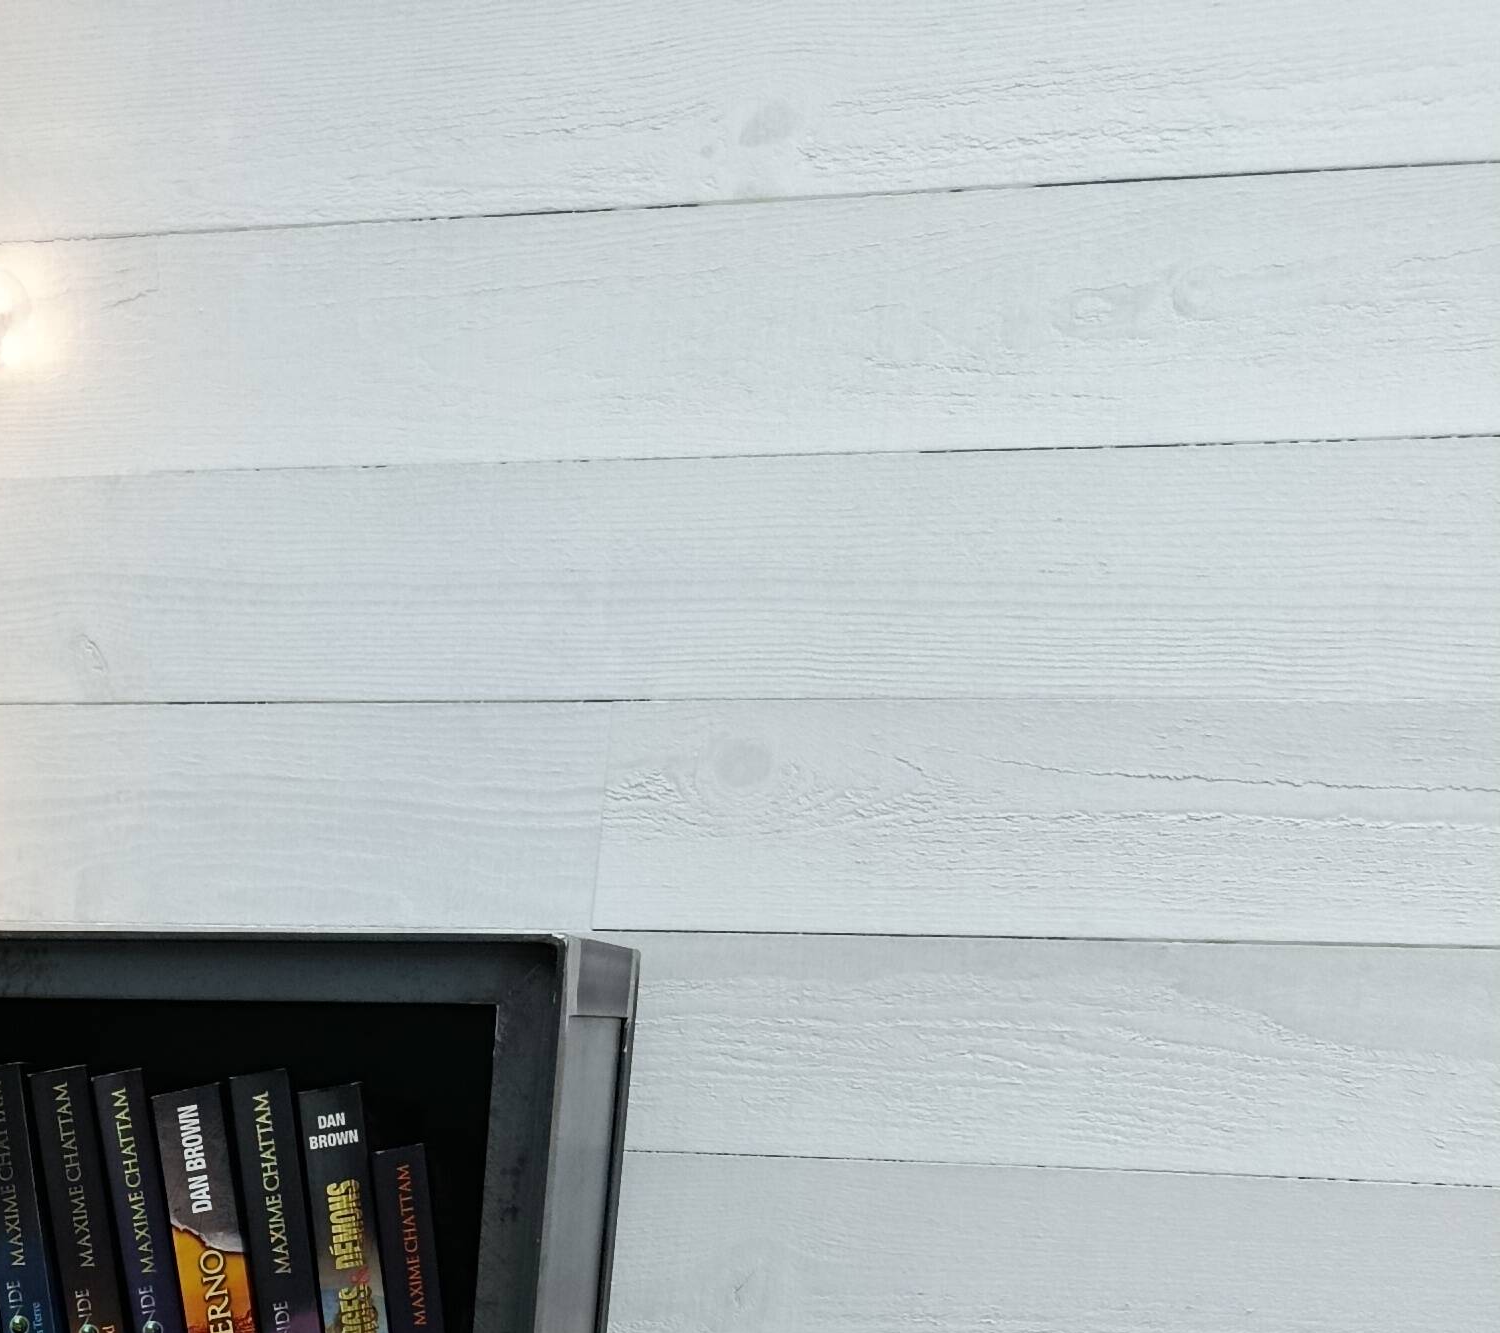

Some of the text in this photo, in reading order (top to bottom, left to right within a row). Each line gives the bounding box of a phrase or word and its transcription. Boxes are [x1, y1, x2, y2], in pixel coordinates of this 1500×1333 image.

[52, 1081, 96, 1268] MAXIME CHATTAM
[111, 1087, 157, 1273] MAXIME CHATTAM
[176, 1103, 213, 1214] DAN BROWN
[252, 1090, 292, 1274] MAXIME CHATTAM
[308, 1129, 359, 1150] BROWN
[317, 1111, 346, 1130] DAN
[0, 1184, 27, 1266] MAXIME
[396, 1164, 428, 1327] MAXIME CHATTAM
